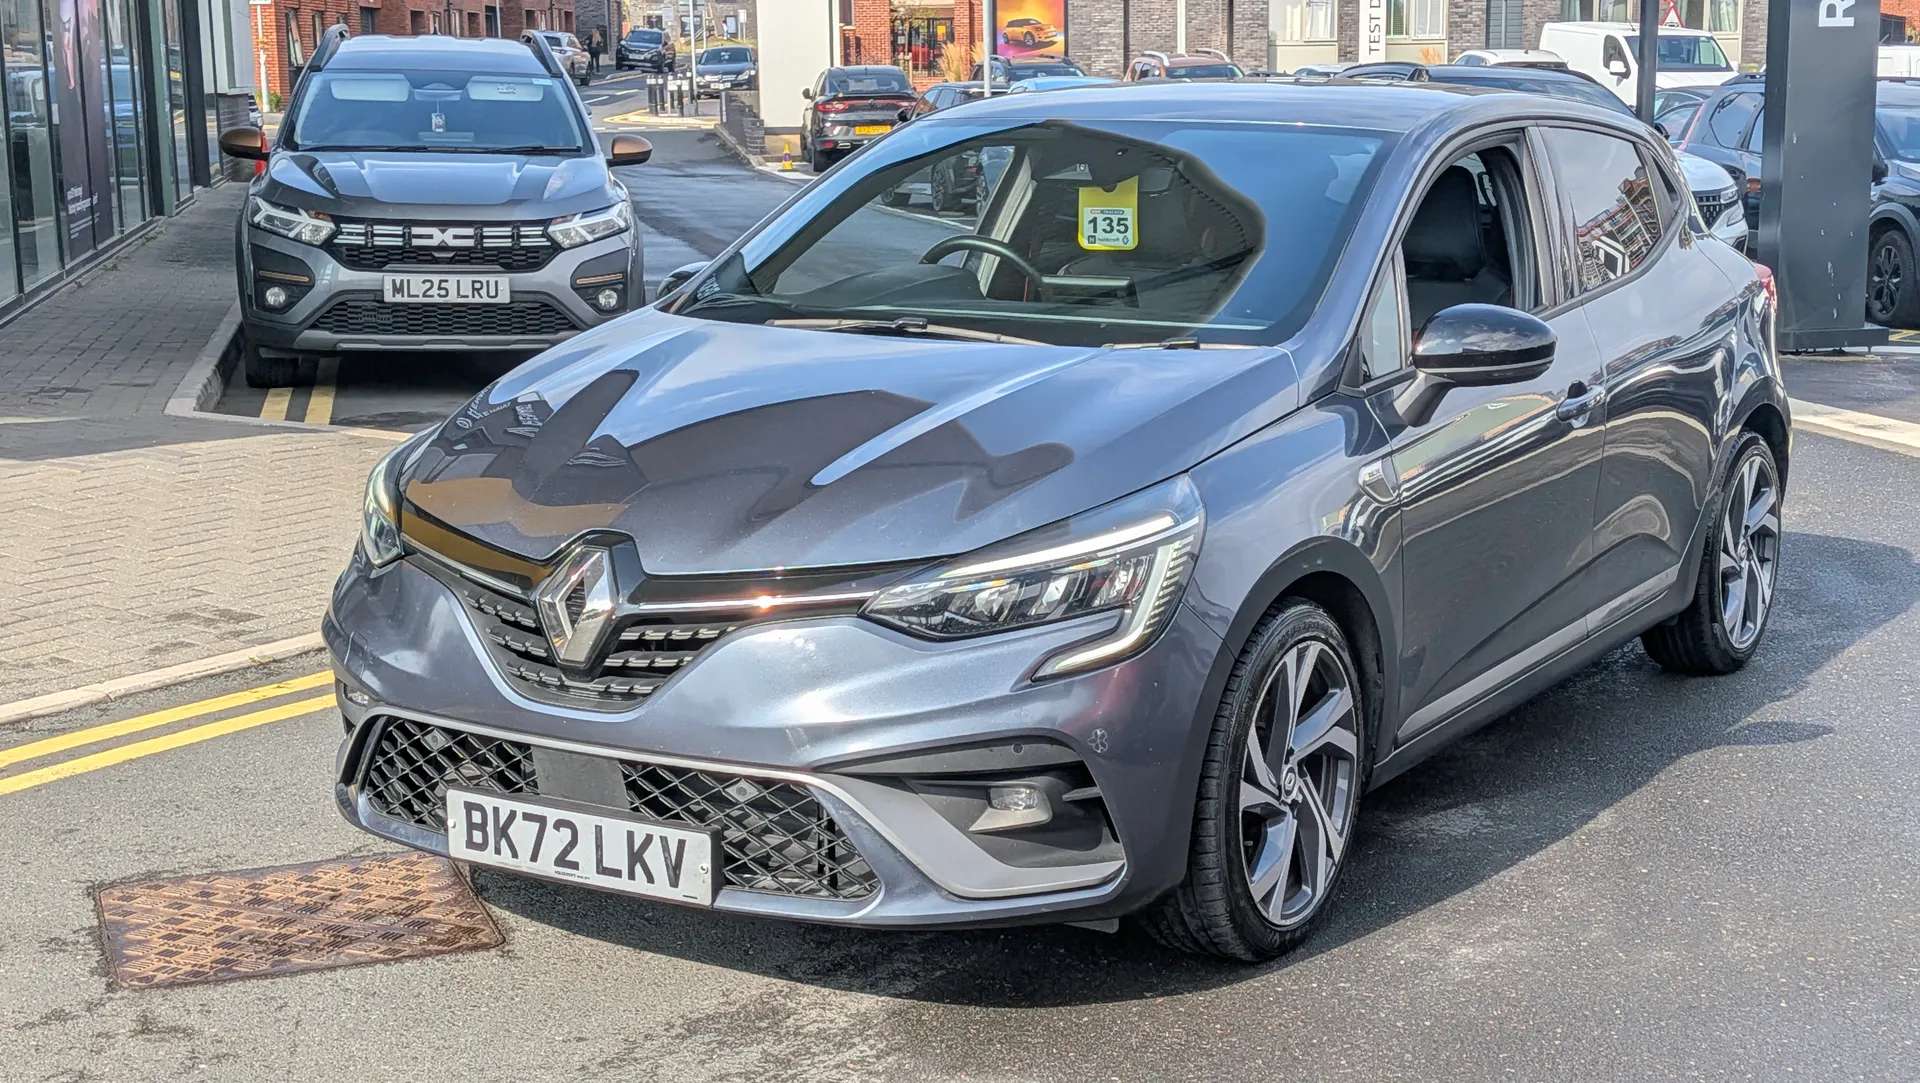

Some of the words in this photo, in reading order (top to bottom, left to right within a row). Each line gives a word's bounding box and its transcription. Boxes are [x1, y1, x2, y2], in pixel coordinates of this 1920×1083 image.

[1368, 13, 1381, 56] TEST
[1088, 217, 1129, 234] 135
[391, 278, 450, 299] ML25
[456, 279, 499, 299] LRU
[463, 800, 581, 871] BK72
[594, 824, 688, 889] LKV
